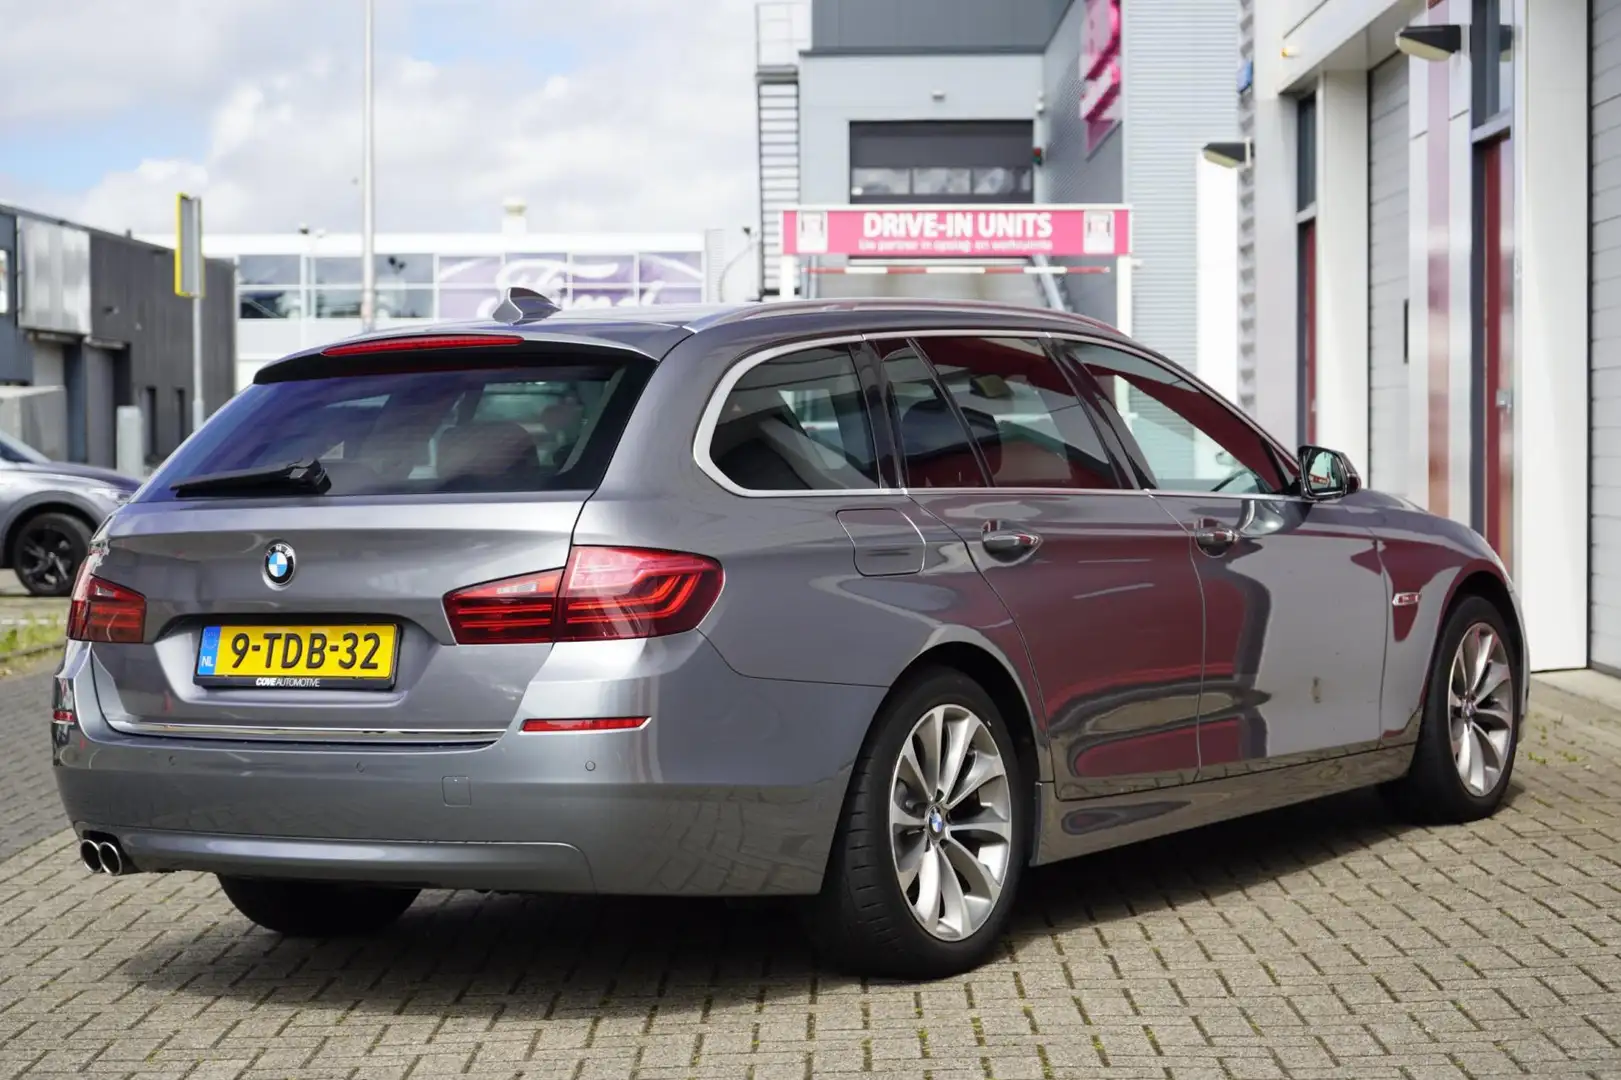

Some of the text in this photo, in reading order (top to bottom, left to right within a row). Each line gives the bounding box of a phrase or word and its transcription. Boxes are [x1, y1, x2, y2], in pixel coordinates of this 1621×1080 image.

[863, 211, 1053, 239] DRIVE-IN UNITS
[201, 632, 380, 670] NL 9-TDB-32
